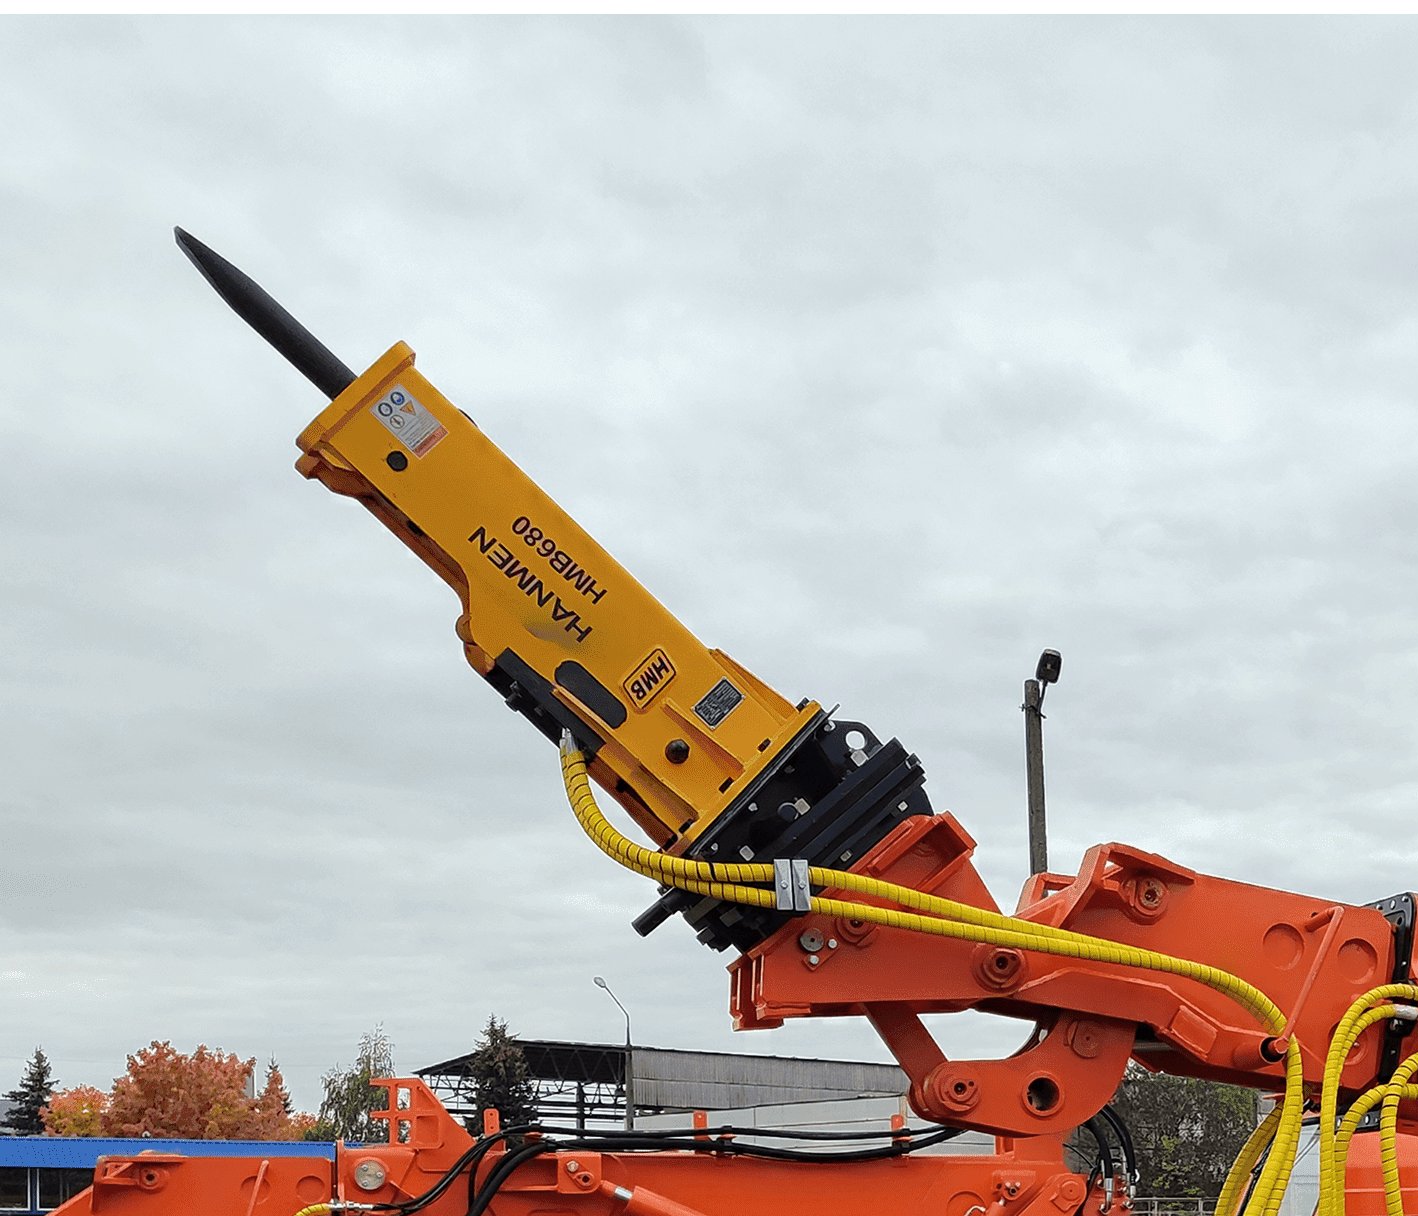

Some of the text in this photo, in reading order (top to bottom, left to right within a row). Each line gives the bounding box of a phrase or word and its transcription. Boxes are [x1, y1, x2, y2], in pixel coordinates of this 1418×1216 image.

[467, 526, 593, 643] HANMEN
[511, 515, 608, 605] HMB680
[630, 655, 669, 700] HMB
